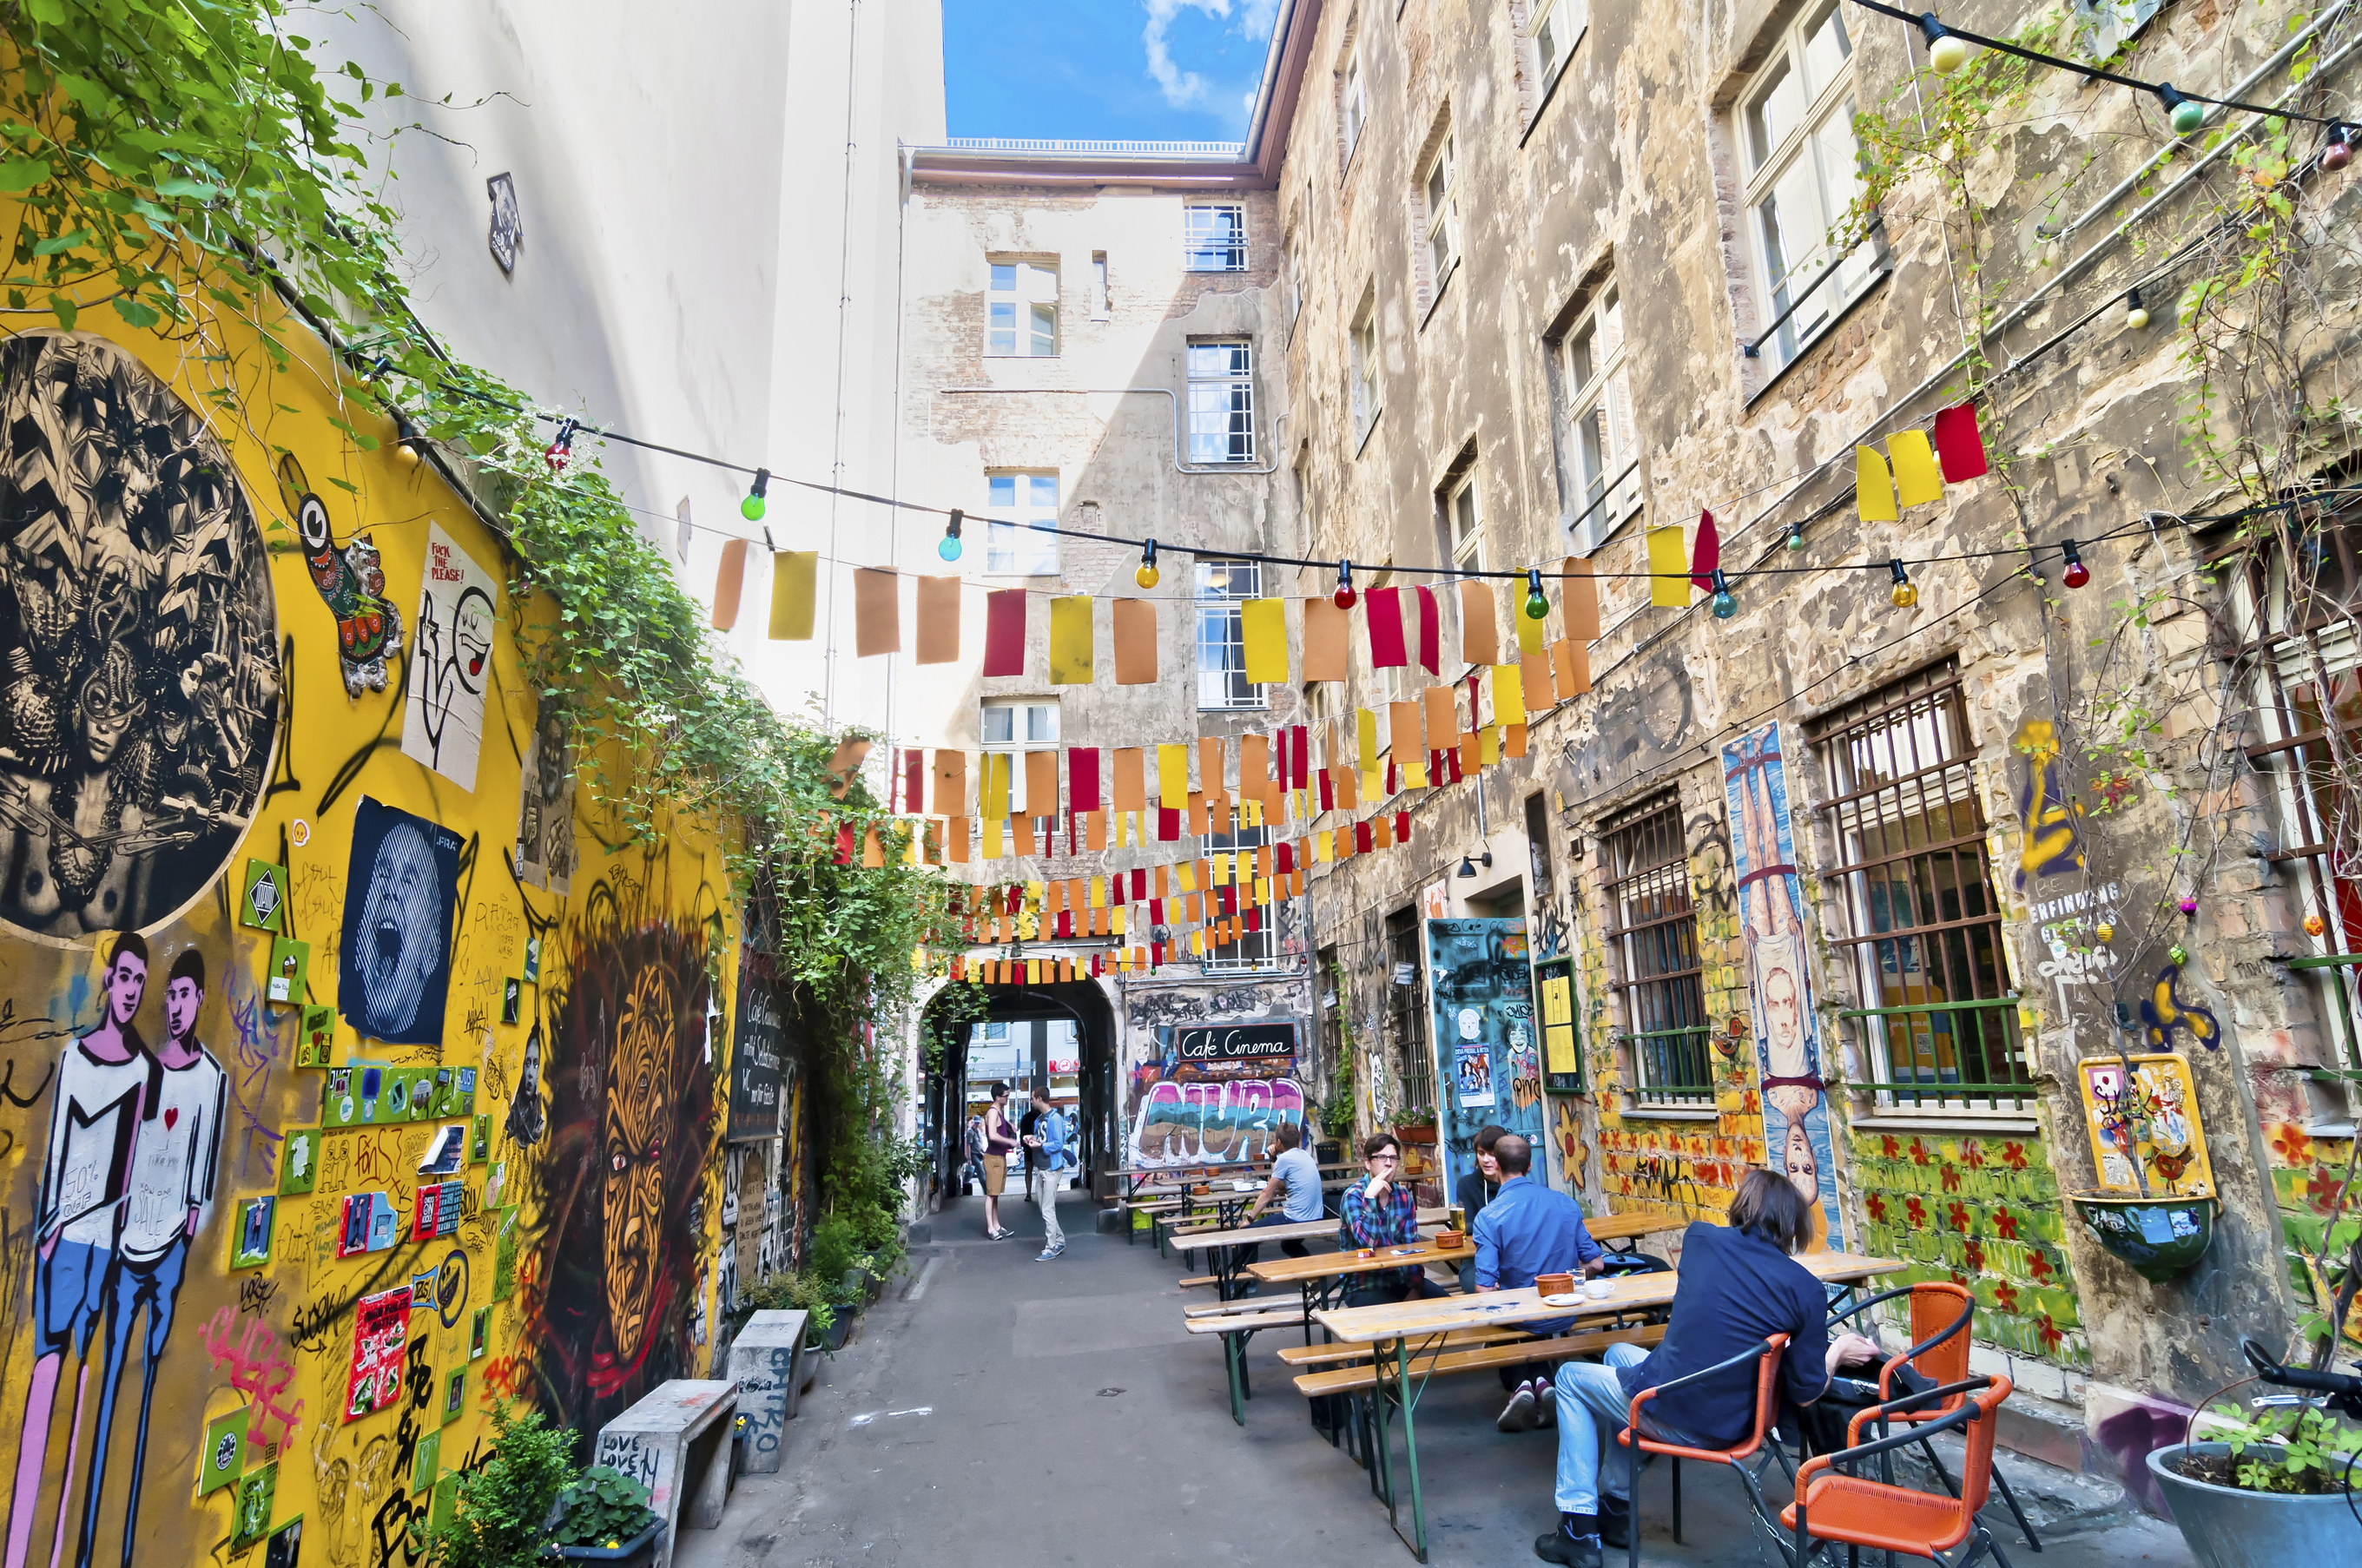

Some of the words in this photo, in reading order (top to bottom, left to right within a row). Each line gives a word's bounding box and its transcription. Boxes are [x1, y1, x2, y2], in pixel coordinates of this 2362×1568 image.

[431, 542, 451, 558] FUCK
[433, 554, 448, 569] THE
[431, 567, 464, 585] PLEASE!
[1182, 1031, 1218, 1060] Café
[1224, 1029, 1291, 1056] Cinema
[63, 1191, 92, 1218] OFF
[604, 1435, 640, 1453] LOVE
[600, 1451, 639, 1471] LOVE
